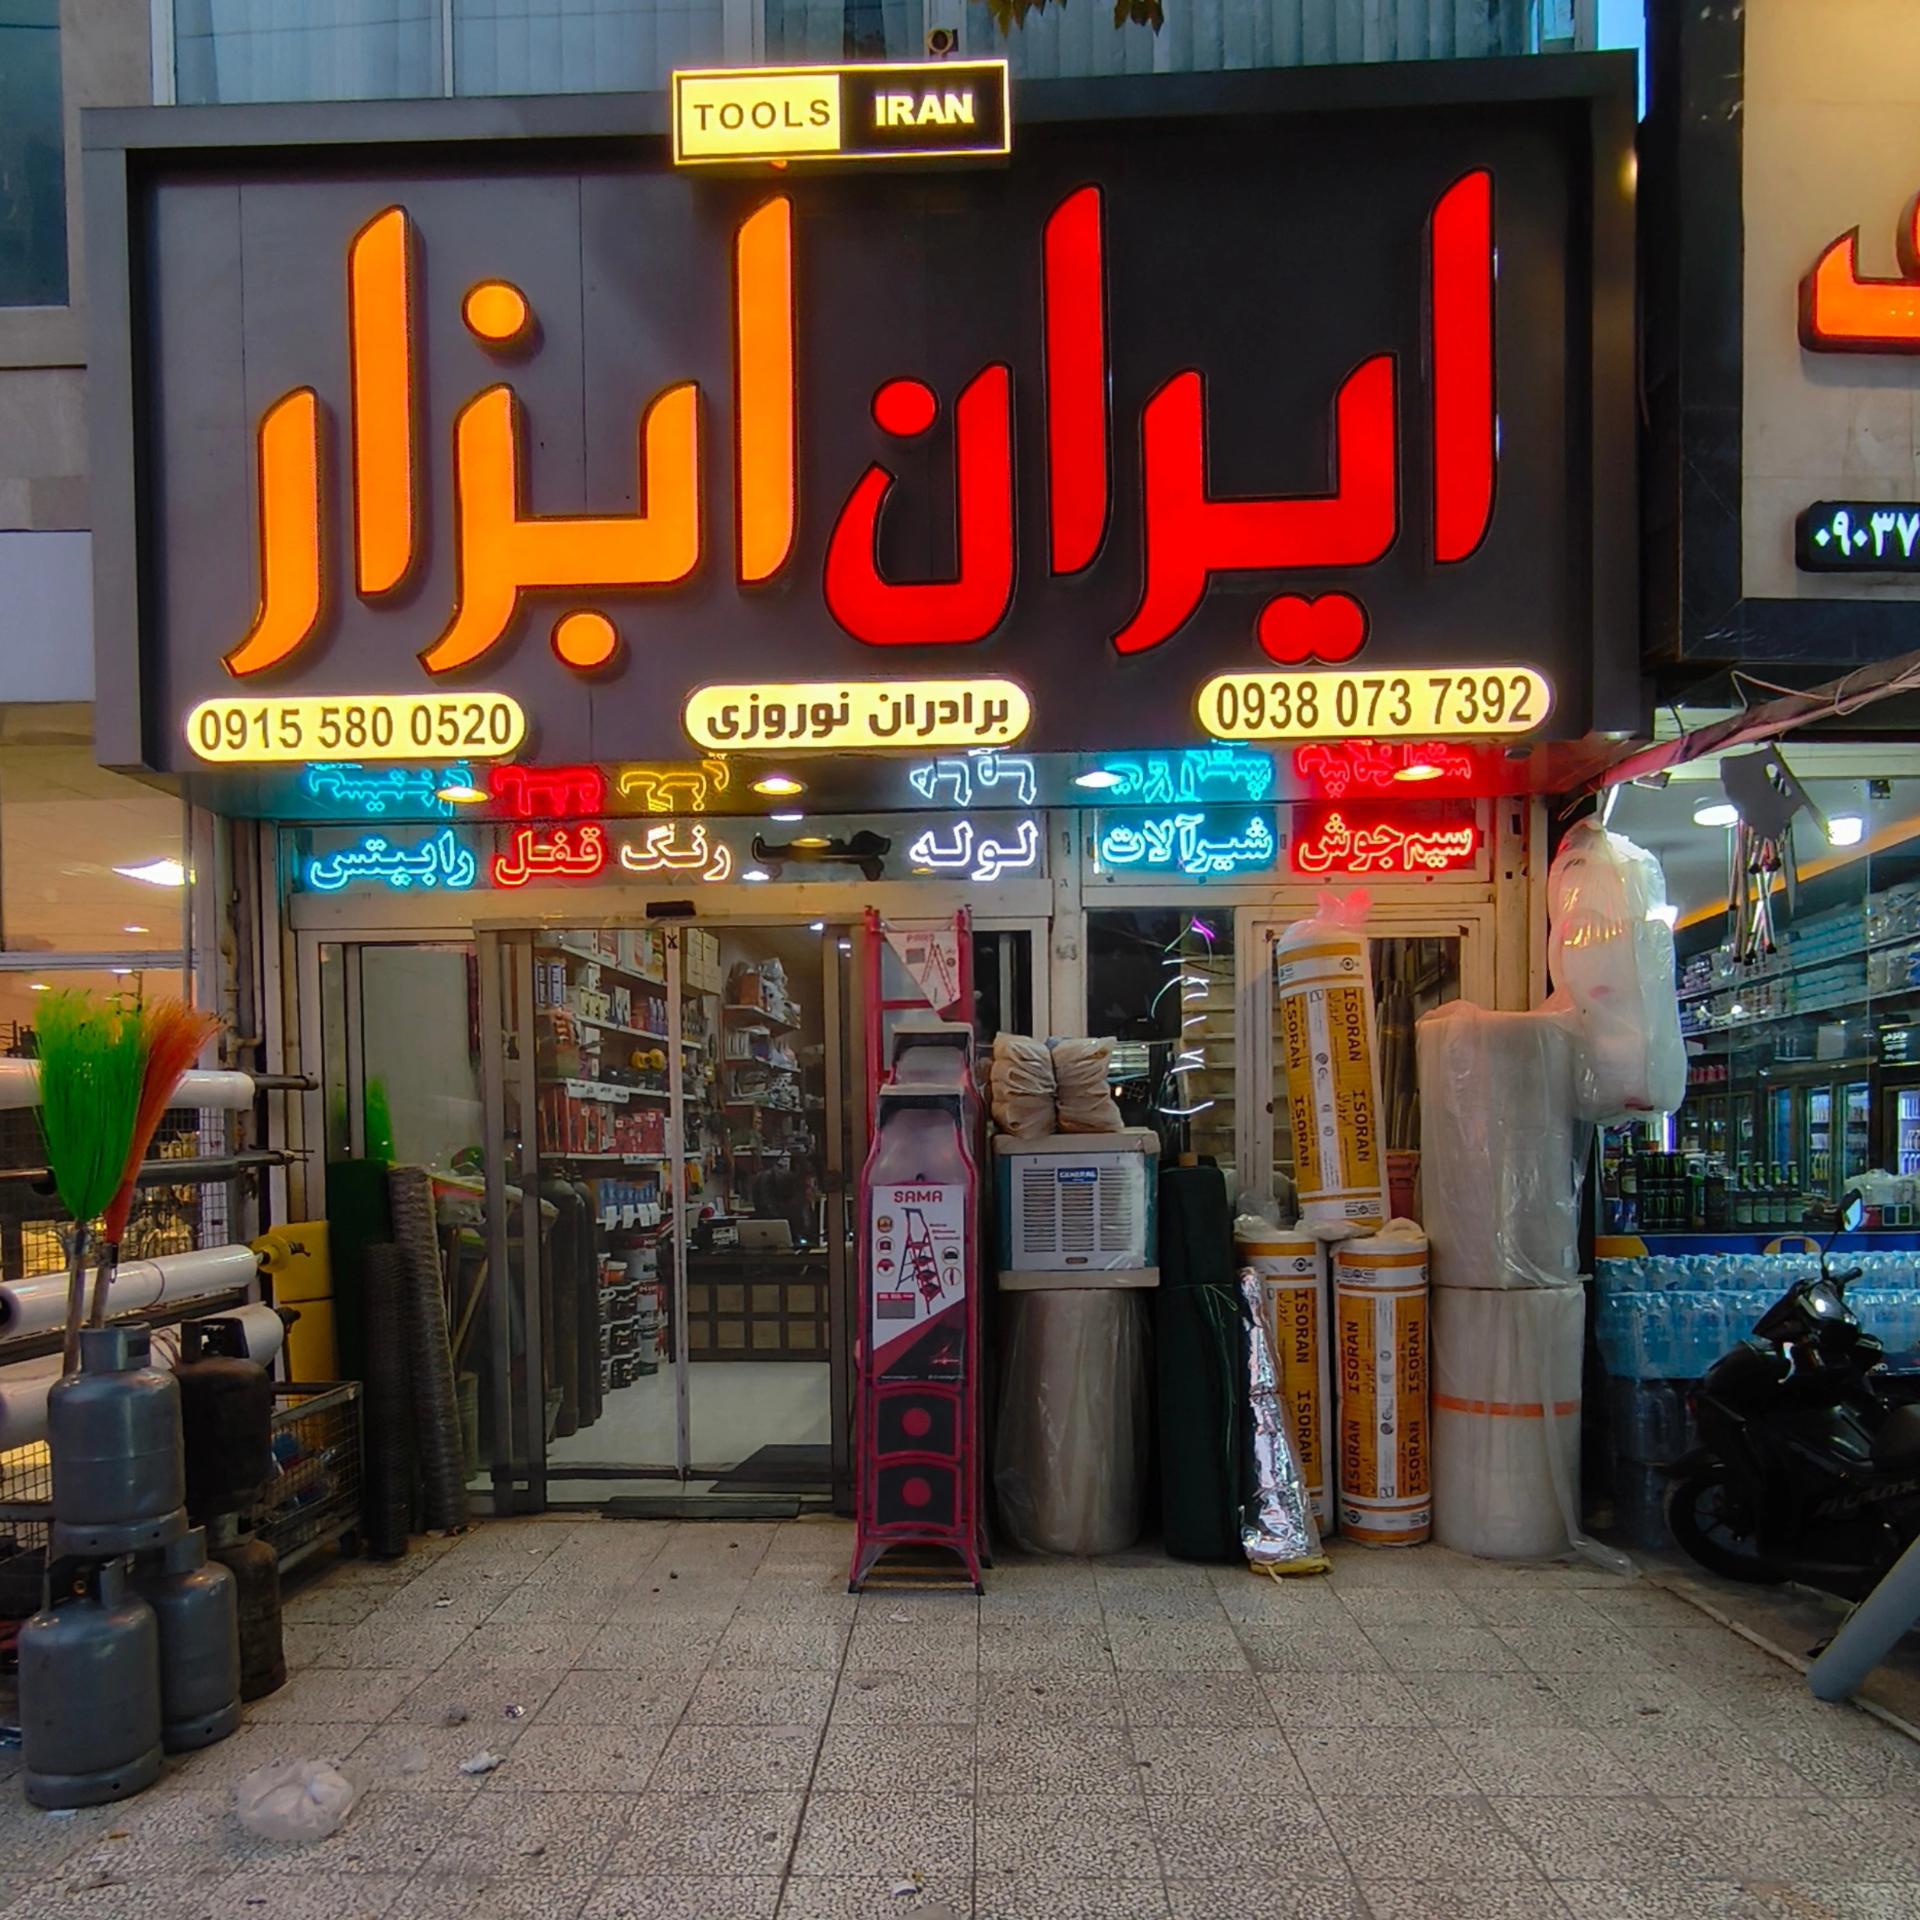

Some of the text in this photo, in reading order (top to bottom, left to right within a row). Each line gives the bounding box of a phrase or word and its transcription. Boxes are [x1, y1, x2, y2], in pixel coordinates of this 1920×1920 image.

[694, 93, 974, 131] TOOLS IRAN
[222, 170, 1494, 676] ایران ابزار
[199, 703, 512, 751] 0915 580 0520
[707, 691, 1009, 740] برادران نوروزی
[1216, 676, 1532, 730] 0938 073 7392
[310, 829, 475, 889] رابیتس
[495, 827, 602, 885] قفل
[620, 823, 731, 881] رنگ
[909, 820, 1039, 882] لوله
[1286, 996, 1301, 1069] ISORAN
[1343, 988, 1362, 1062] ISORAN
[1294, 1096, 1310, 1168] ISORAN
[1353, 1088, 1370, 1163] ISORAN
[893, 1190, 943, 1203] SAMA
[1295, 1289, 1310, 1364] ISORAN
[1346, 1320, 1360, 1394] ISORAN
[1408, 1319, 1421, 1395] ISORAN
[1297, 1390, 1312, 1464] ISORAN
[1347, 1419, 1361, 1494] ISORAN
[1408, 1419, 1422, 1495] ISORAN
